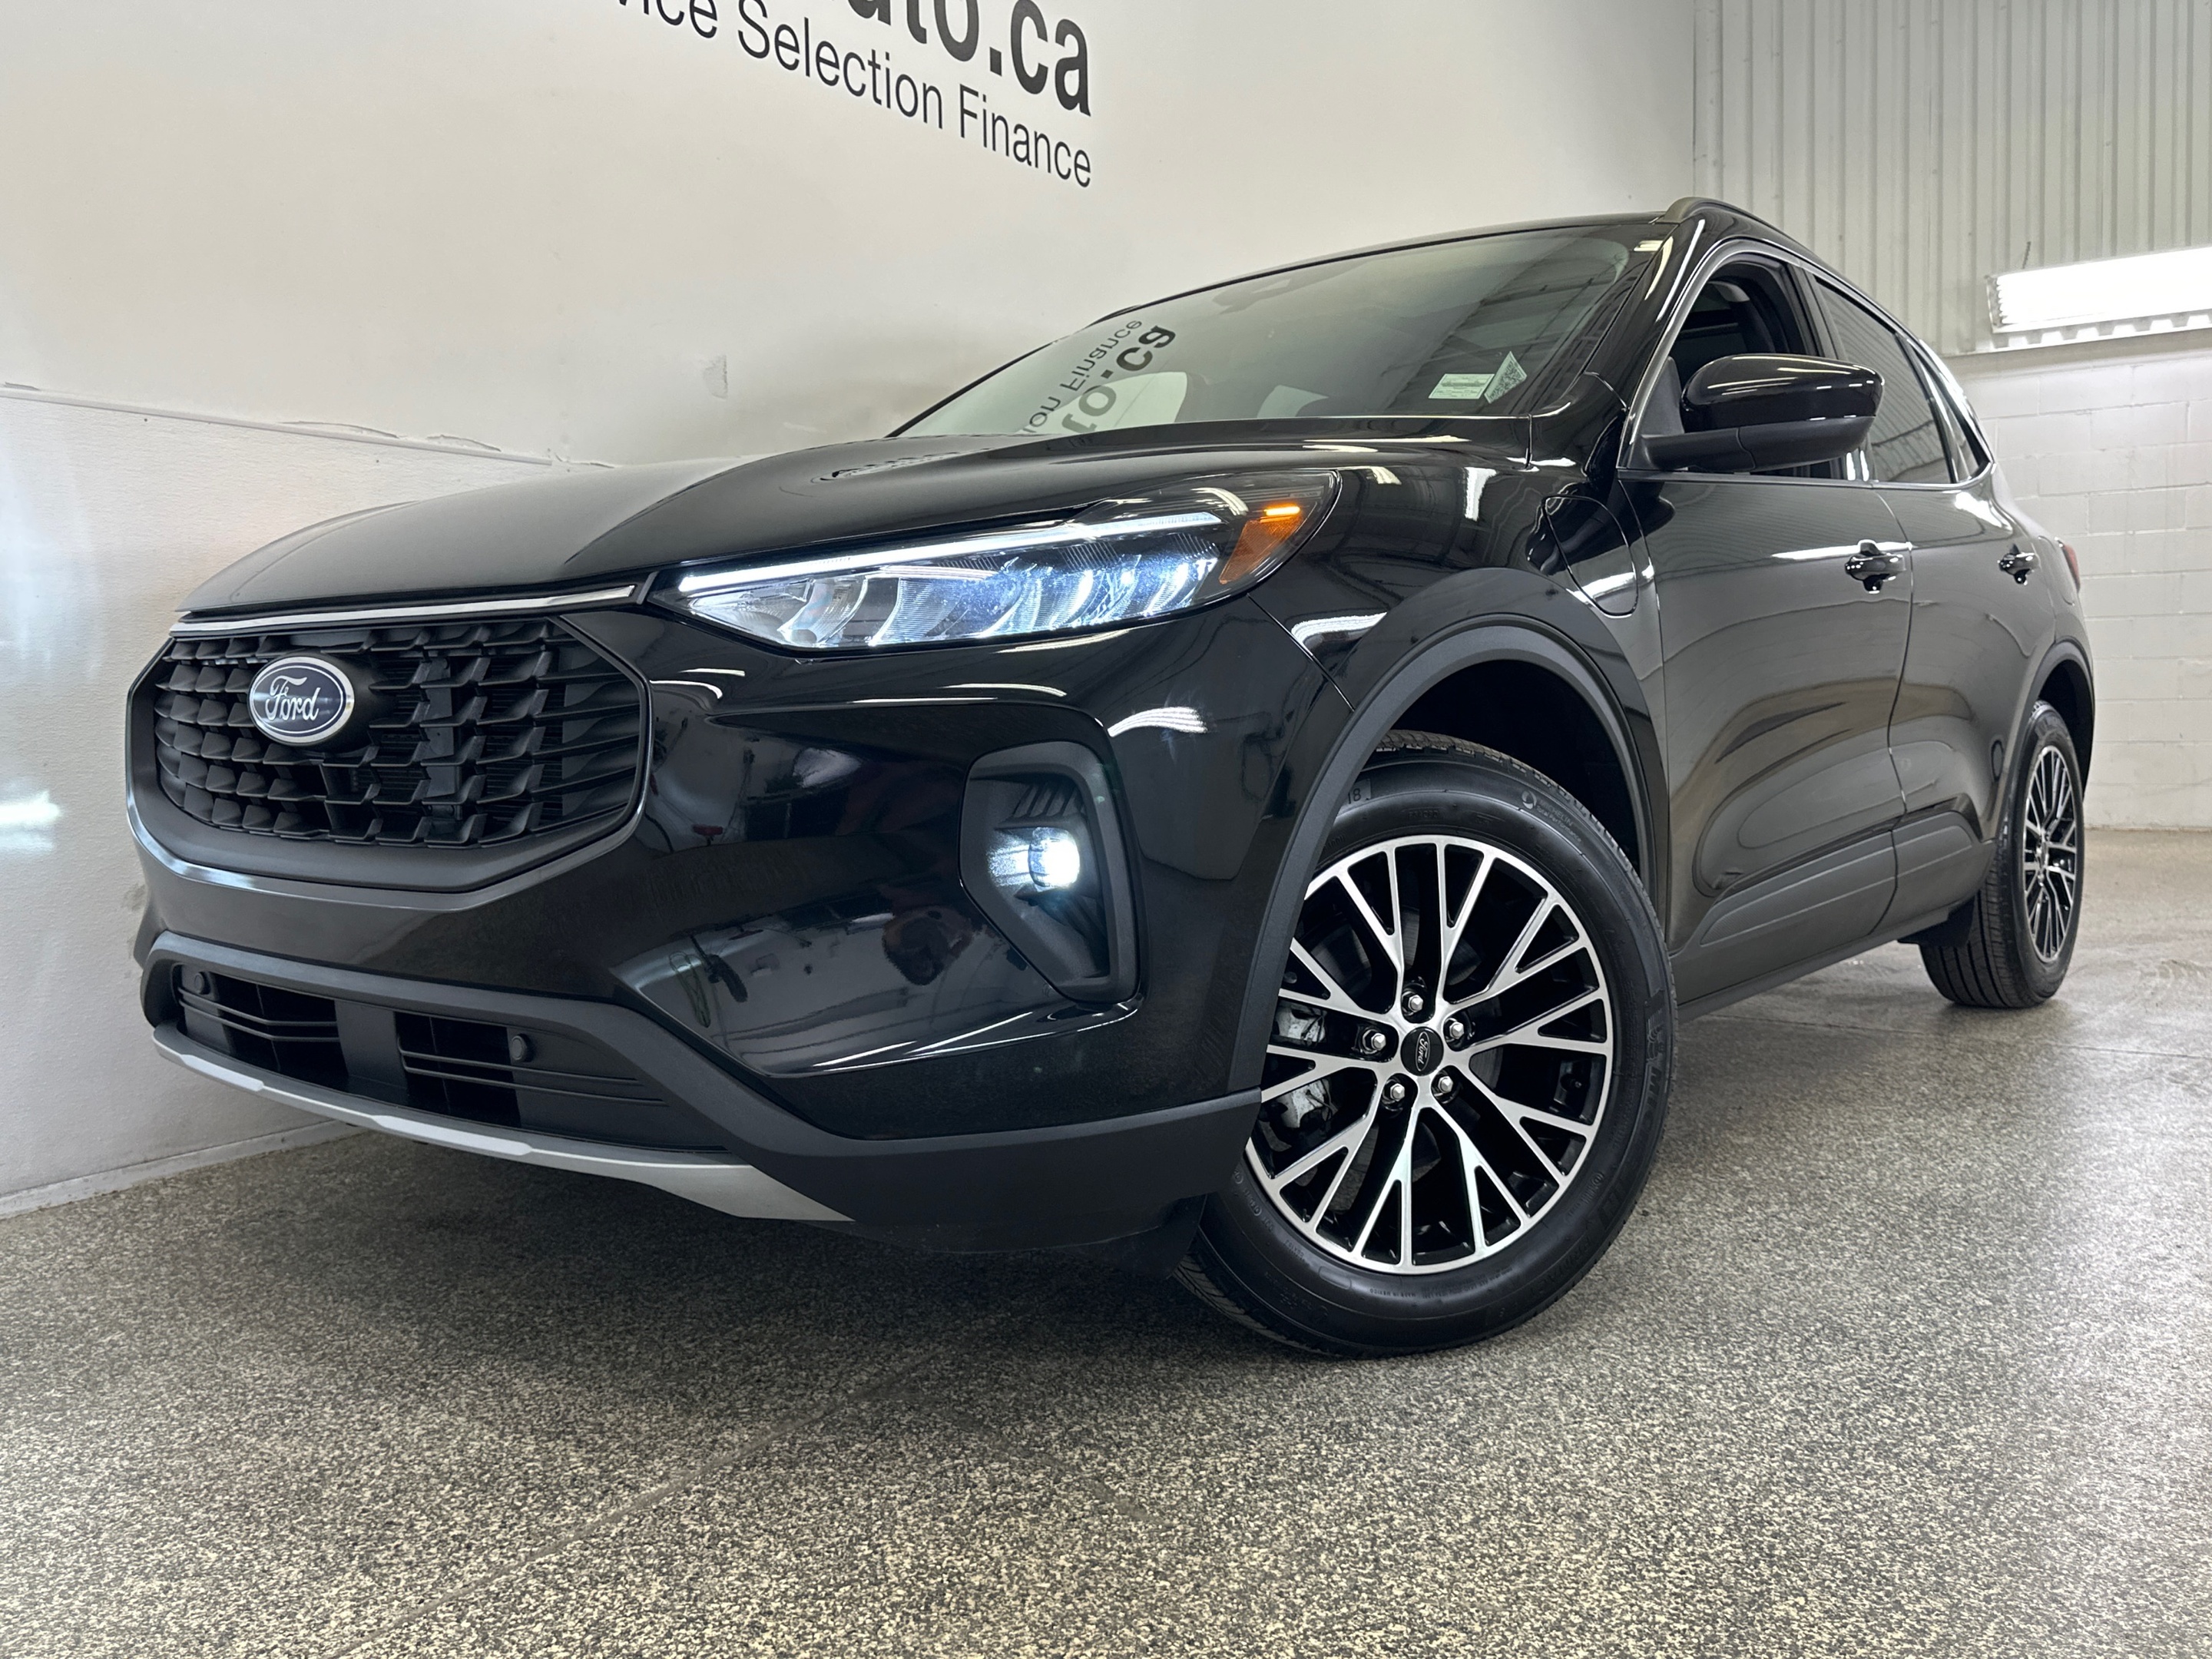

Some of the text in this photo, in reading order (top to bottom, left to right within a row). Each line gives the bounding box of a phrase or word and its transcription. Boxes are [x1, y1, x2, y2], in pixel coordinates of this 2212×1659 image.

[738, 0, 942, 129] Selection
[959, 83, 1091, 187] Finance
[265, 675, 321, 721] Ford
[1347, 788, 1362, 805] 18
